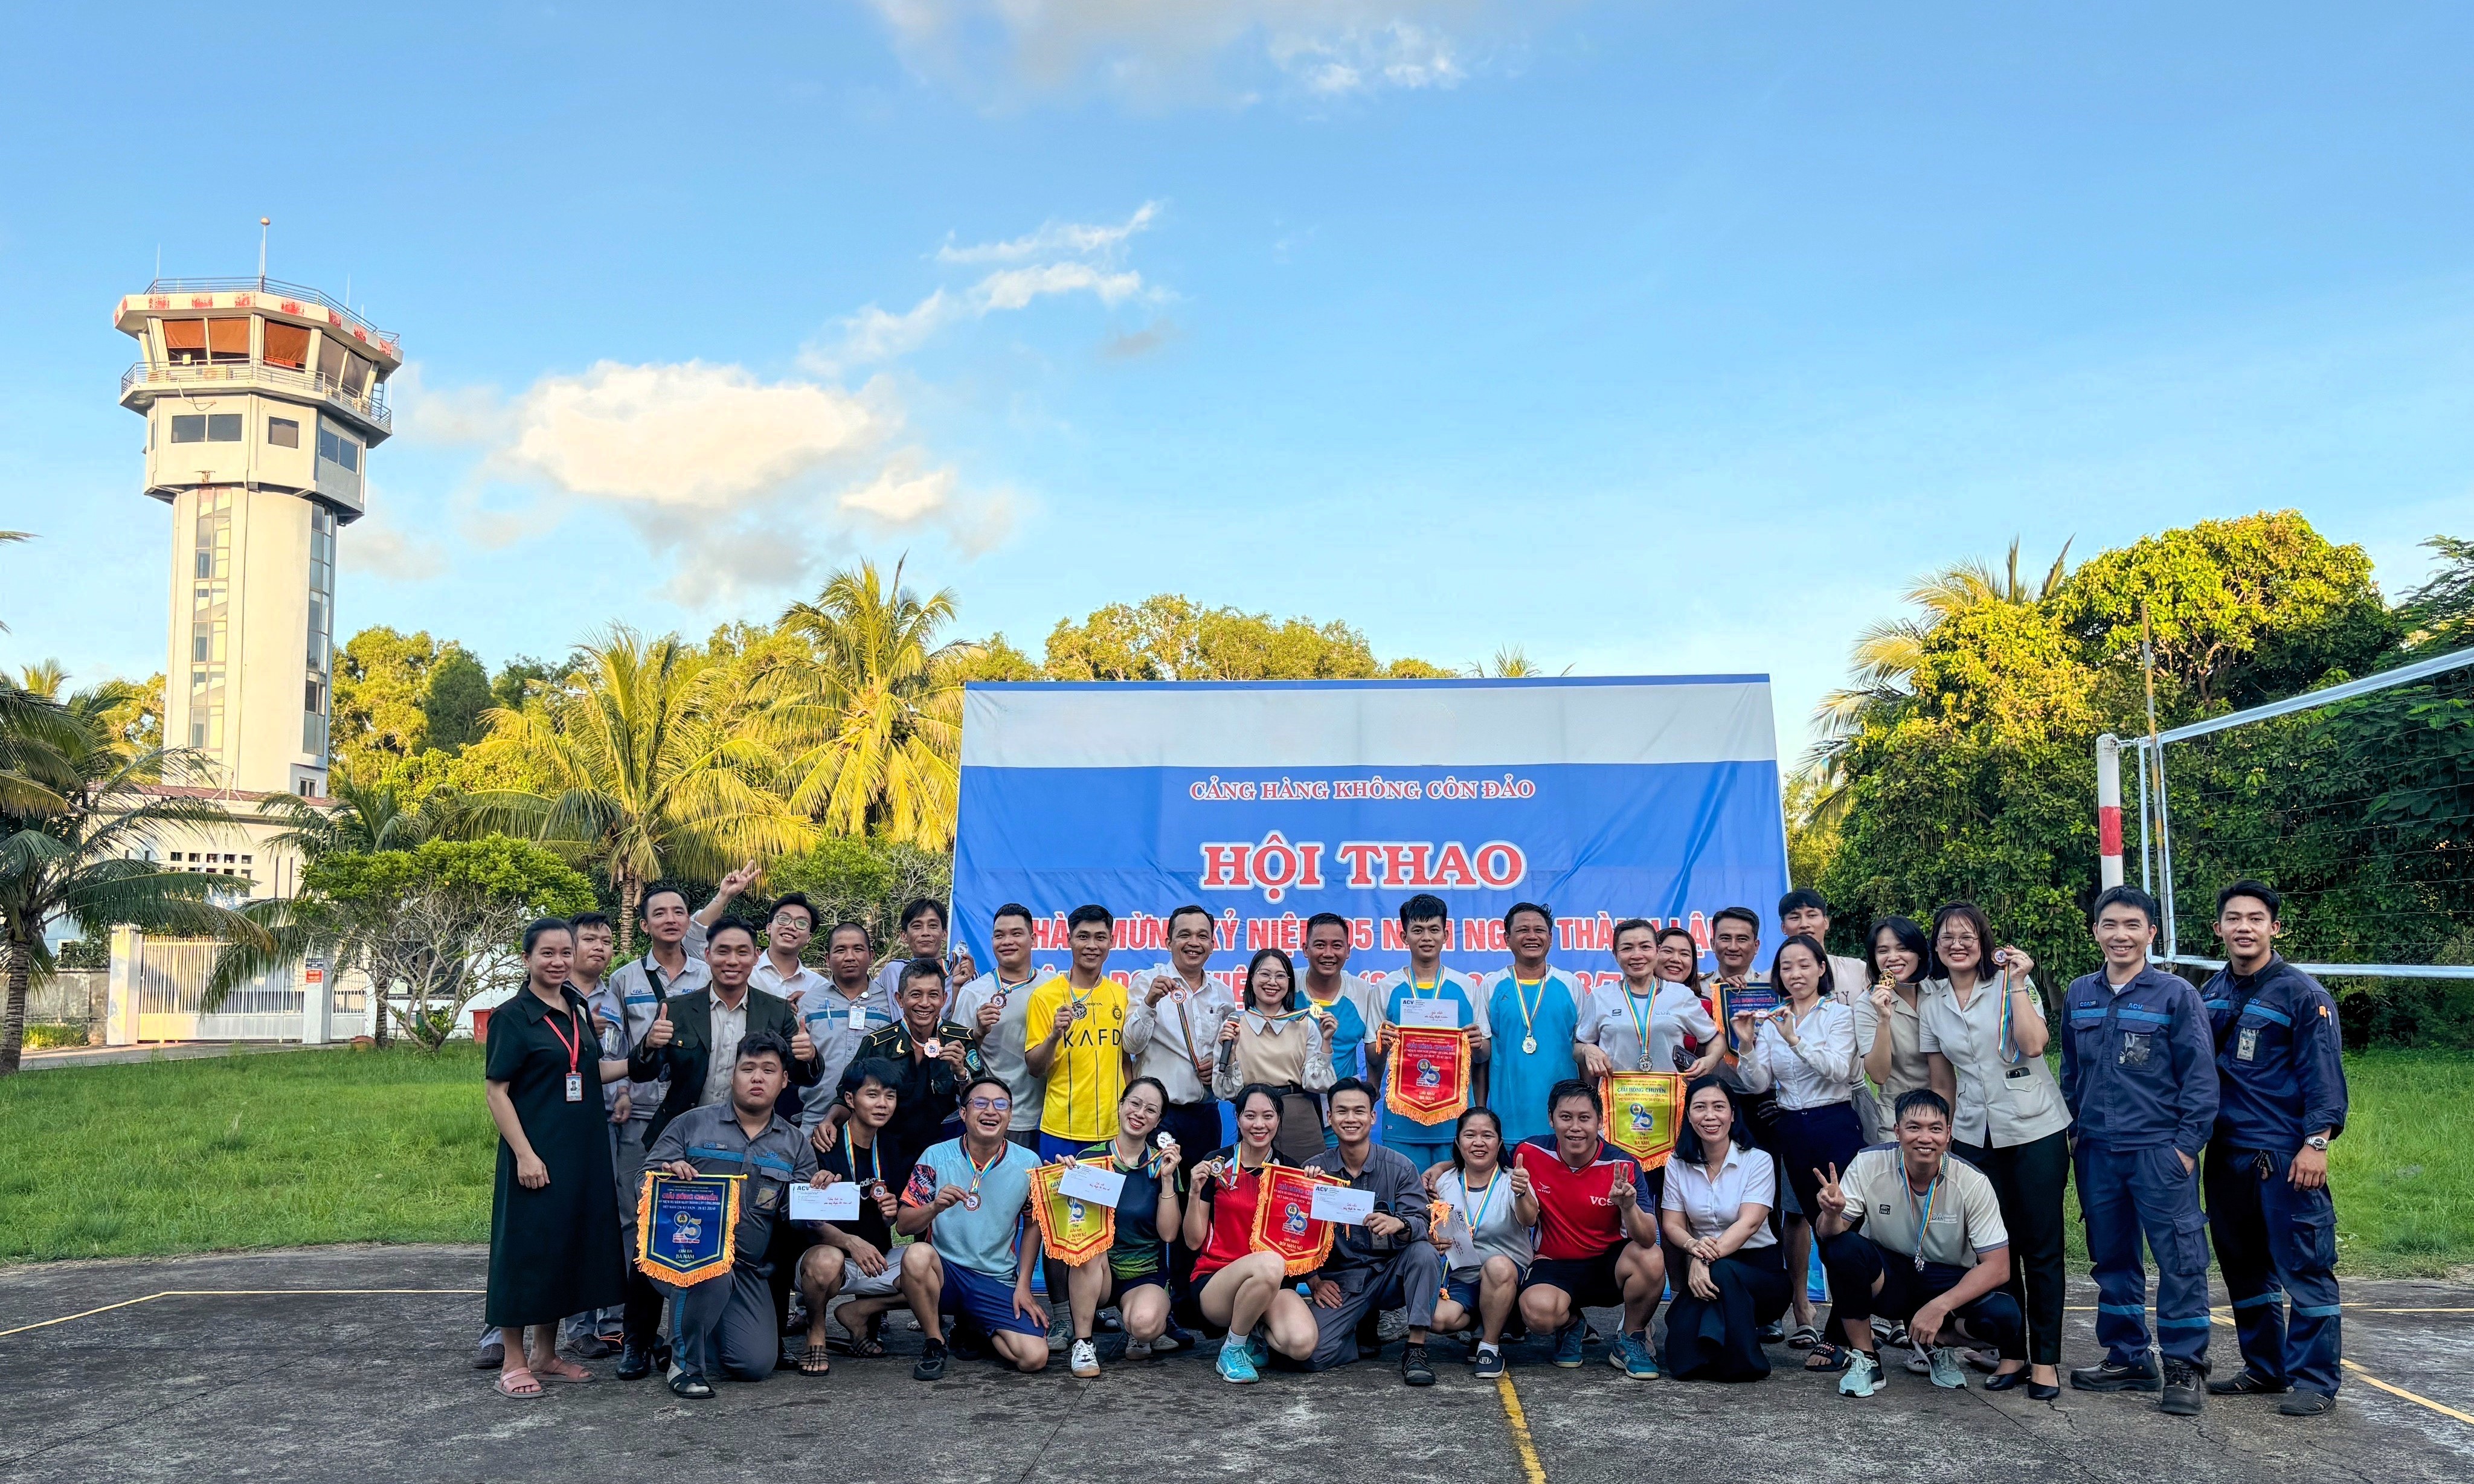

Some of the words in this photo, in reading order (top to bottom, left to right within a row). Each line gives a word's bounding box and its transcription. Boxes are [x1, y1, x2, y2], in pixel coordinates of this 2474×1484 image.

[1190, 776, 1256, 800] CẢNG
[1261, 777, 1329, 799] HÀNG
[1334, 776, 1421, 798] KHÔNG
[1427, 776, 1478, 798] CÔN
[1482, 774, 1535, 798] ĐẢO
[1202, 832, 1322, 901] HỘI
[1338, 843, 1524, 887] THAO
[1110, 913, 1169, 949] MỪN
[1063, 1029, 1122, 1049] KAFD
